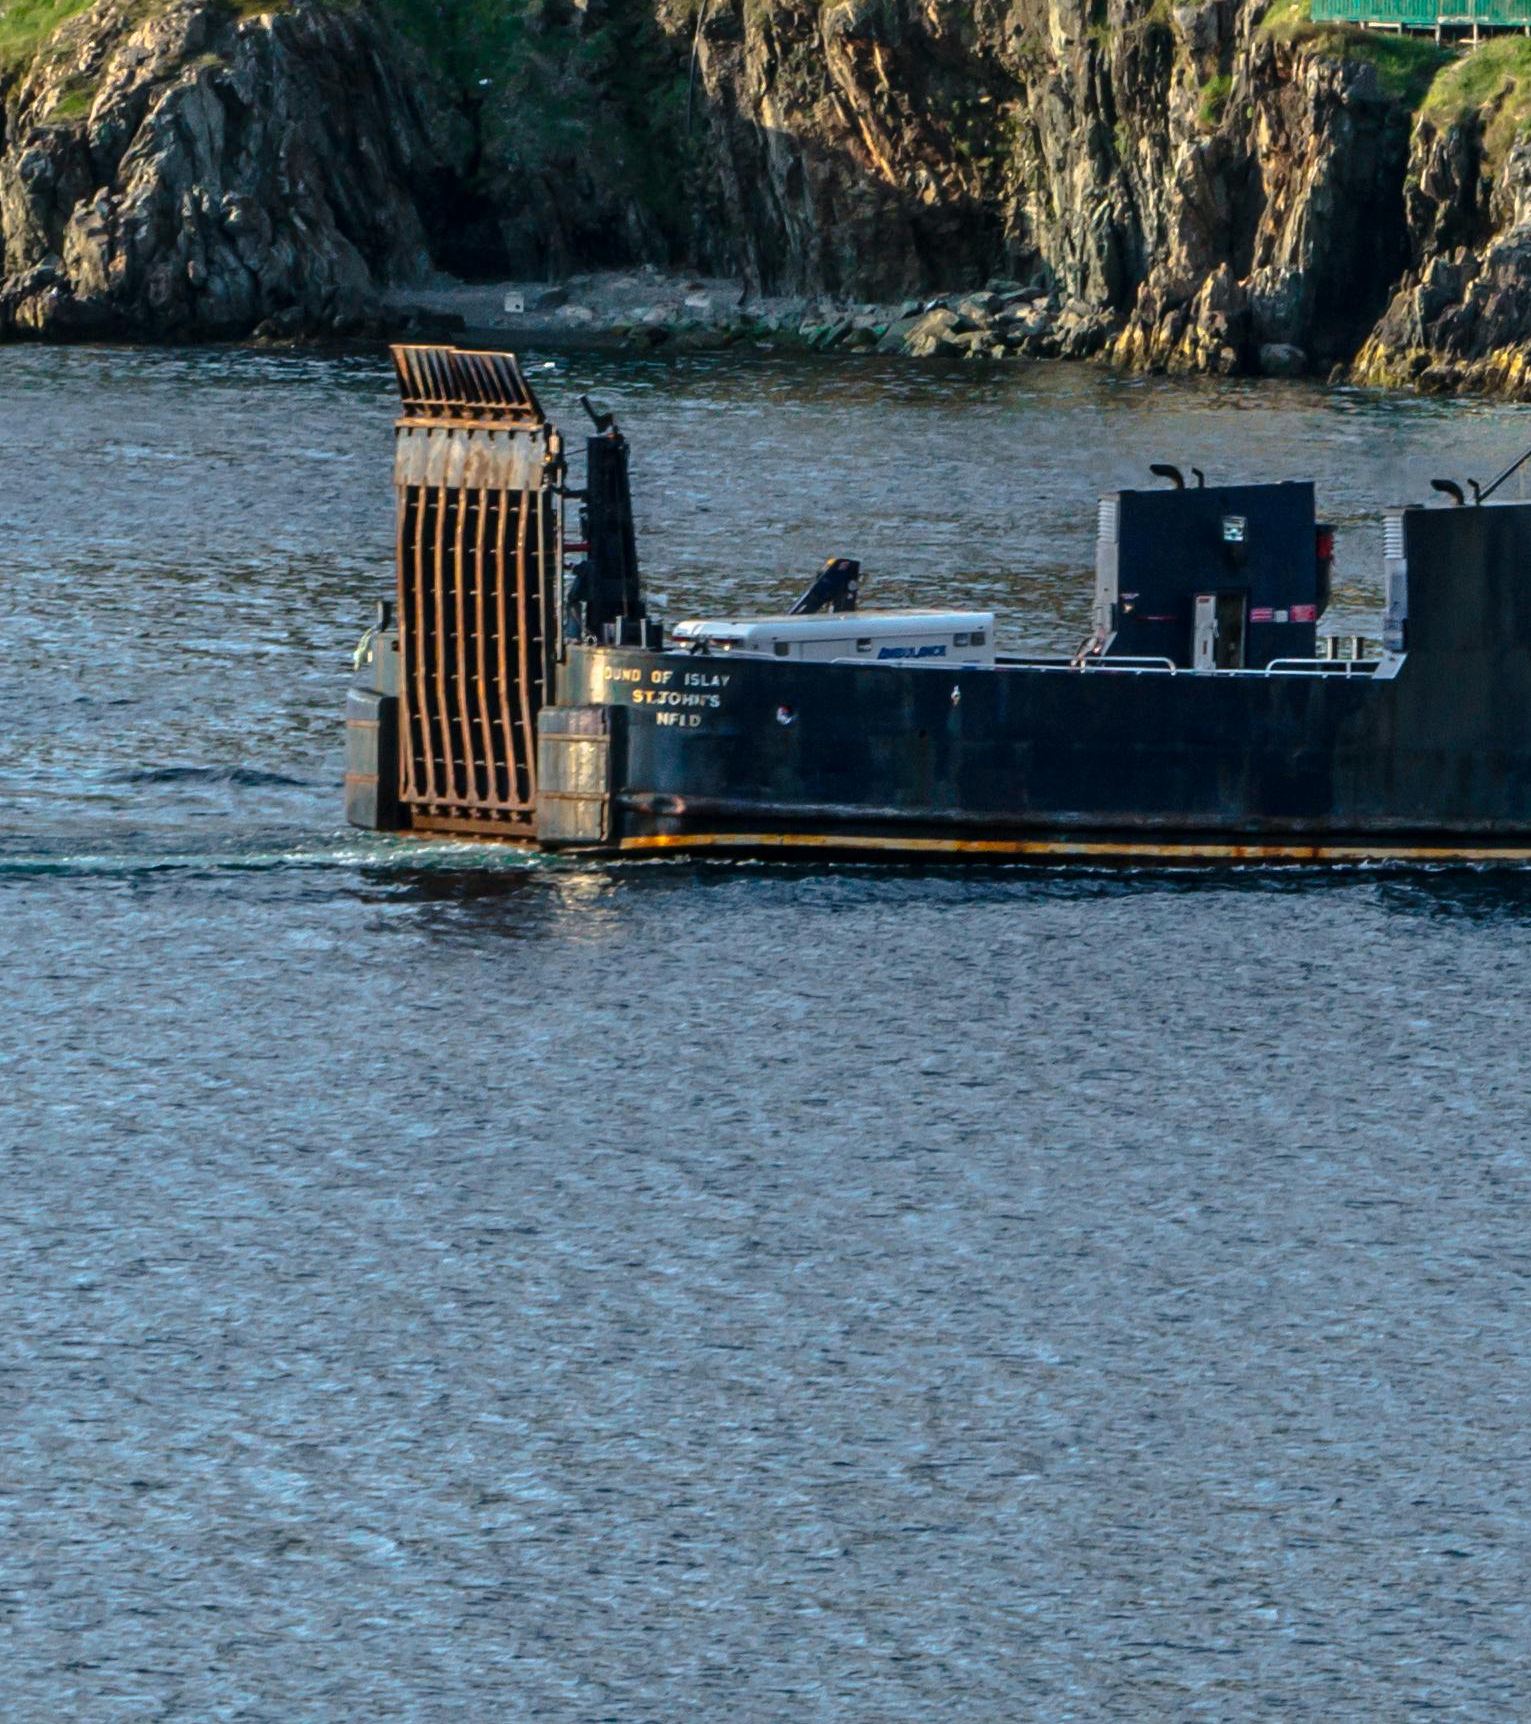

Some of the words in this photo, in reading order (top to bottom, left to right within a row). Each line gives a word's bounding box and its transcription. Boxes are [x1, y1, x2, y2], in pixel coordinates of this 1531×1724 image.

[602, 666, 642, 682] OUND
[650, 670, 674, 684] OF
[684, 672, 730, 687] ISLAY
